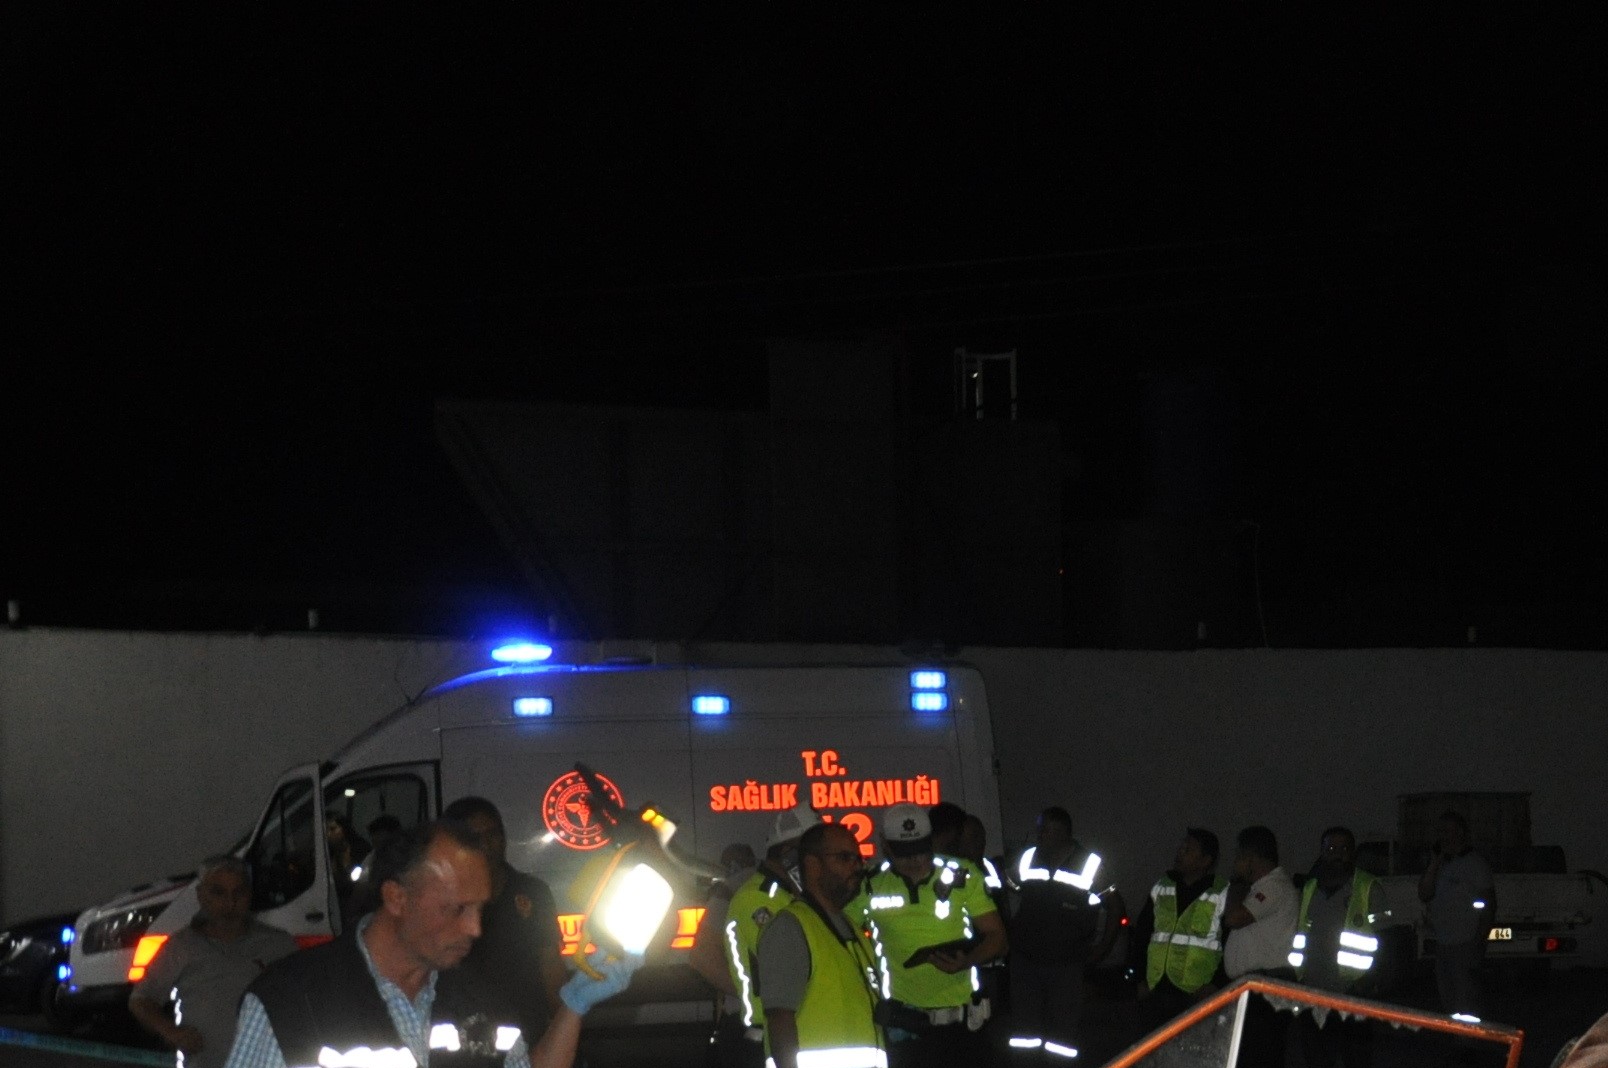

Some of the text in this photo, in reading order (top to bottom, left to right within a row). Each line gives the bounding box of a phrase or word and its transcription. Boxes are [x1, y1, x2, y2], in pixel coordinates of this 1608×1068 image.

[801, 750, 846, 777] T.C.
[710, 775, 939, 811] SAĞLIK BAKANLIĞI
